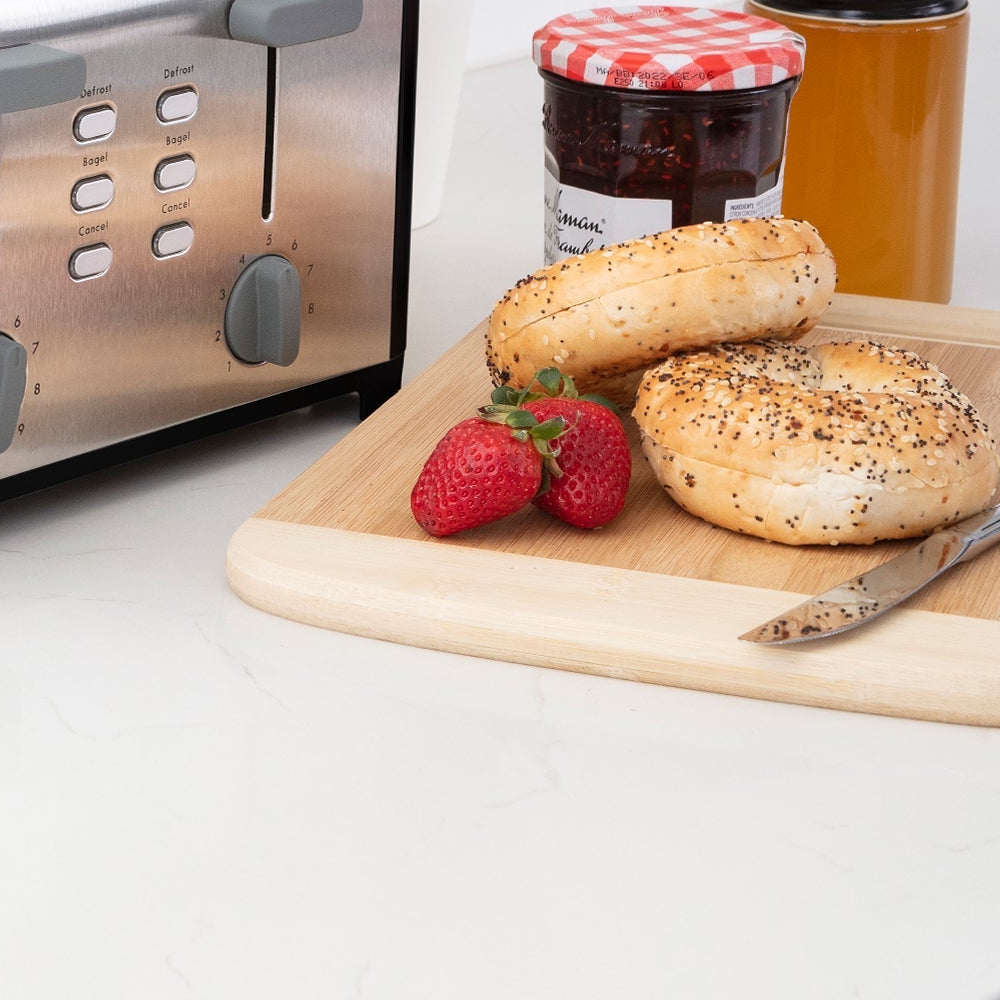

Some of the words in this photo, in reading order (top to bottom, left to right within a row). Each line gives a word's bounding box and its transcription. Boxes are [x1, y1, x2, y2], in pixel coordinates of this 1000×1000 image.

[163, 64, 195, 79] Defrost
[79, 84, 112, 99] Defrost
[165, 130, 191, 146] Bagel
[82, 151, 109, 167] Bagel
[161, 198, 191, 215] Cancel
[78, 220, 109, 237] Cancel
[266, 234, 272, 246] 5
[291, 239, 298, 251] 6
[239, 254, 245, 264] 4
[306, 264, 314, 277] 7
[219, 288, 226, 300] 3
[308, 303, 314, 315] 8
[14, 315, 21, 328] 6
[215, 330, 221, 342] 2
[31, 341, 40, 355] 7
[33, 383, 41, 395] 8
[18, 423, 25, 436] 9
